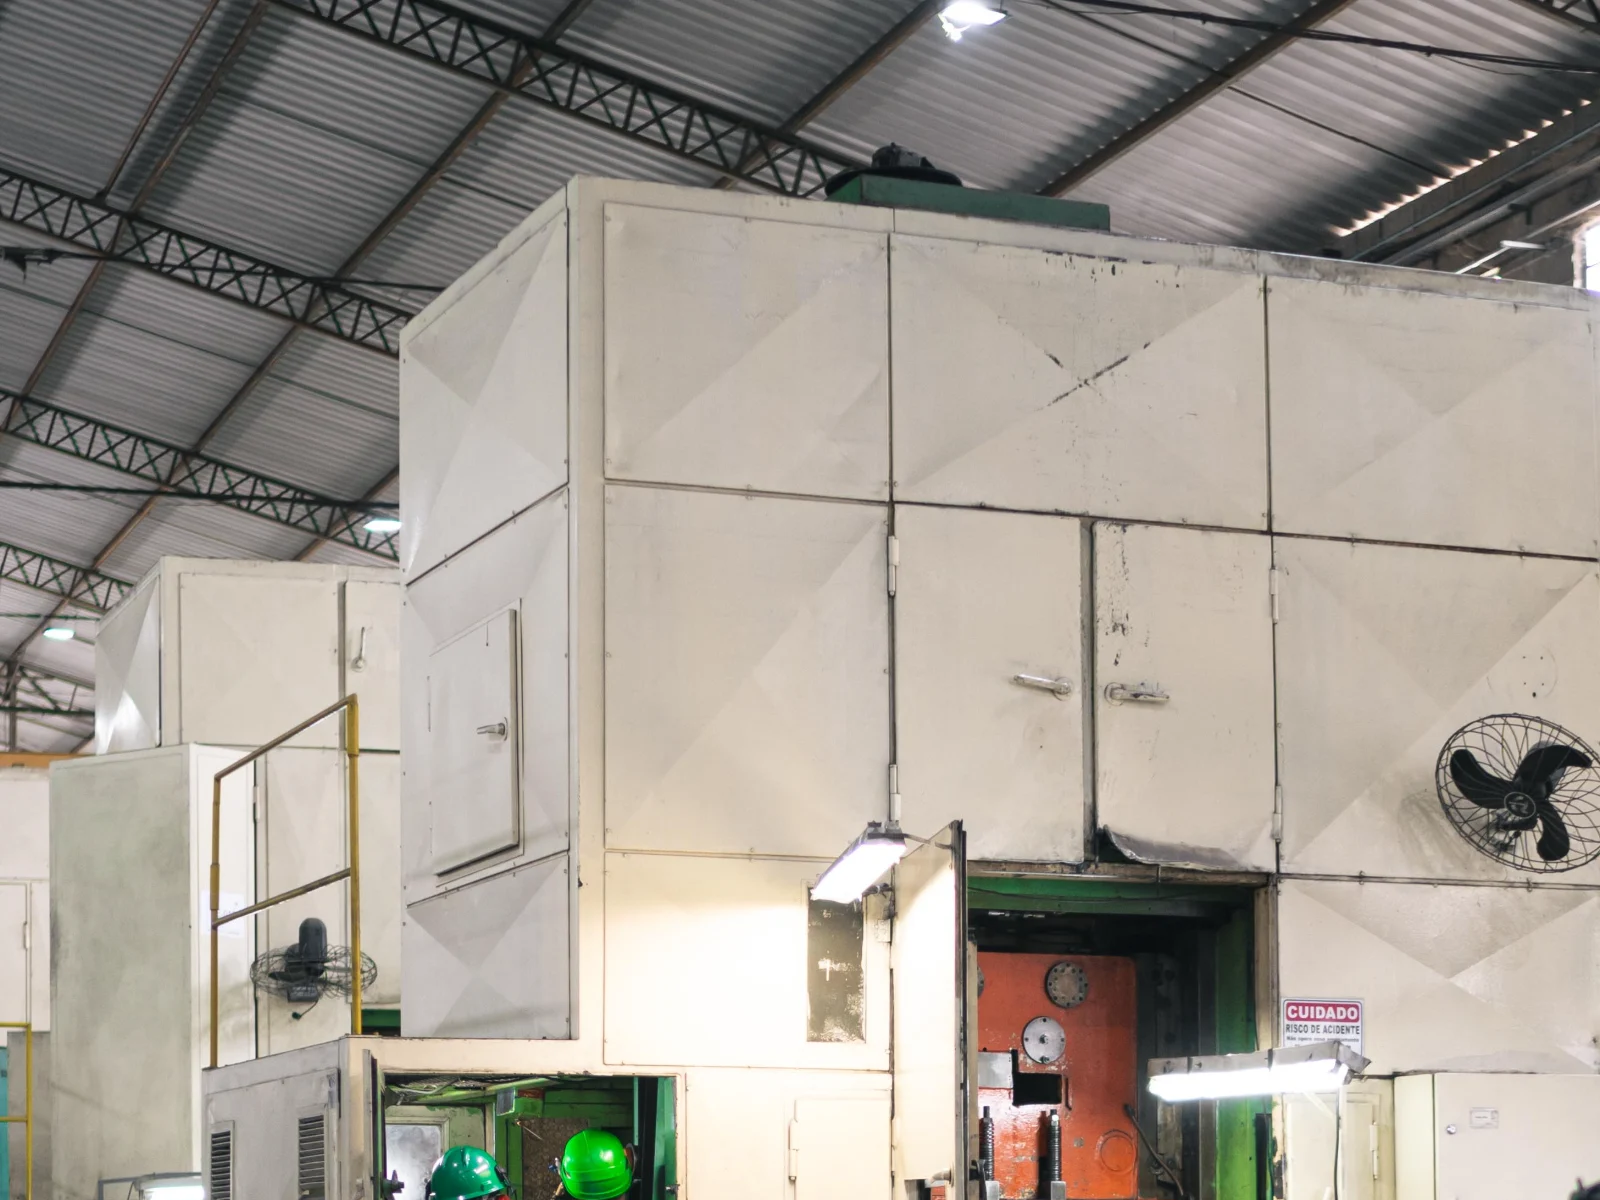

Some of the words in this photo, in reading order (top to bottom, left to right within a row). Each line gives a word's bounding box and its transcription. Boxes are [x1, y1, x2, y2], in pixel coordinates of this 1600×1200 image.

[1287, 1005, 1358, 1020] CUIDADO
[1286, 1024, 1309, 1034] RISCO
[1311, 1024, 1320, 1034] DE
[1323, 1025, 1360, 1034] ACIDENTE
